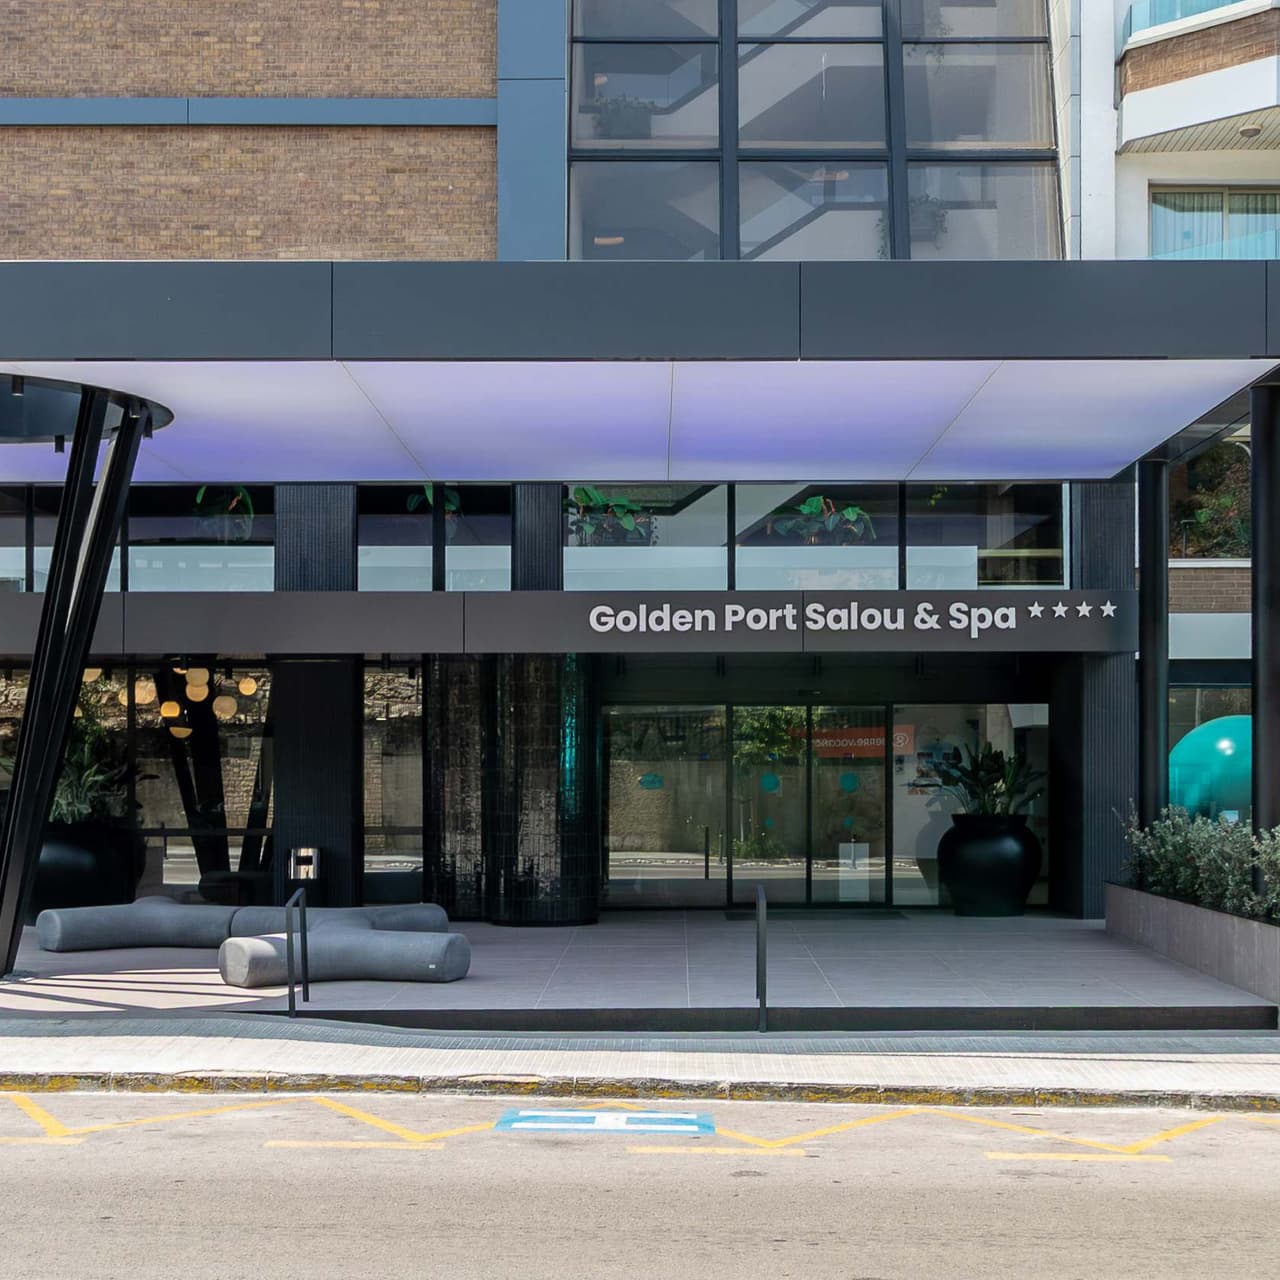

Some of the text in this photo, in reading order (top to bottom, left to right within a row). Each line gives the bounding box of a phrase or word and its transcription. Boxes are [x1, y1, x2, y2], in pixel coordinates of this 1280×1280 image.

[588, 600, 1018, 640] Golden Port Salou & Spa
